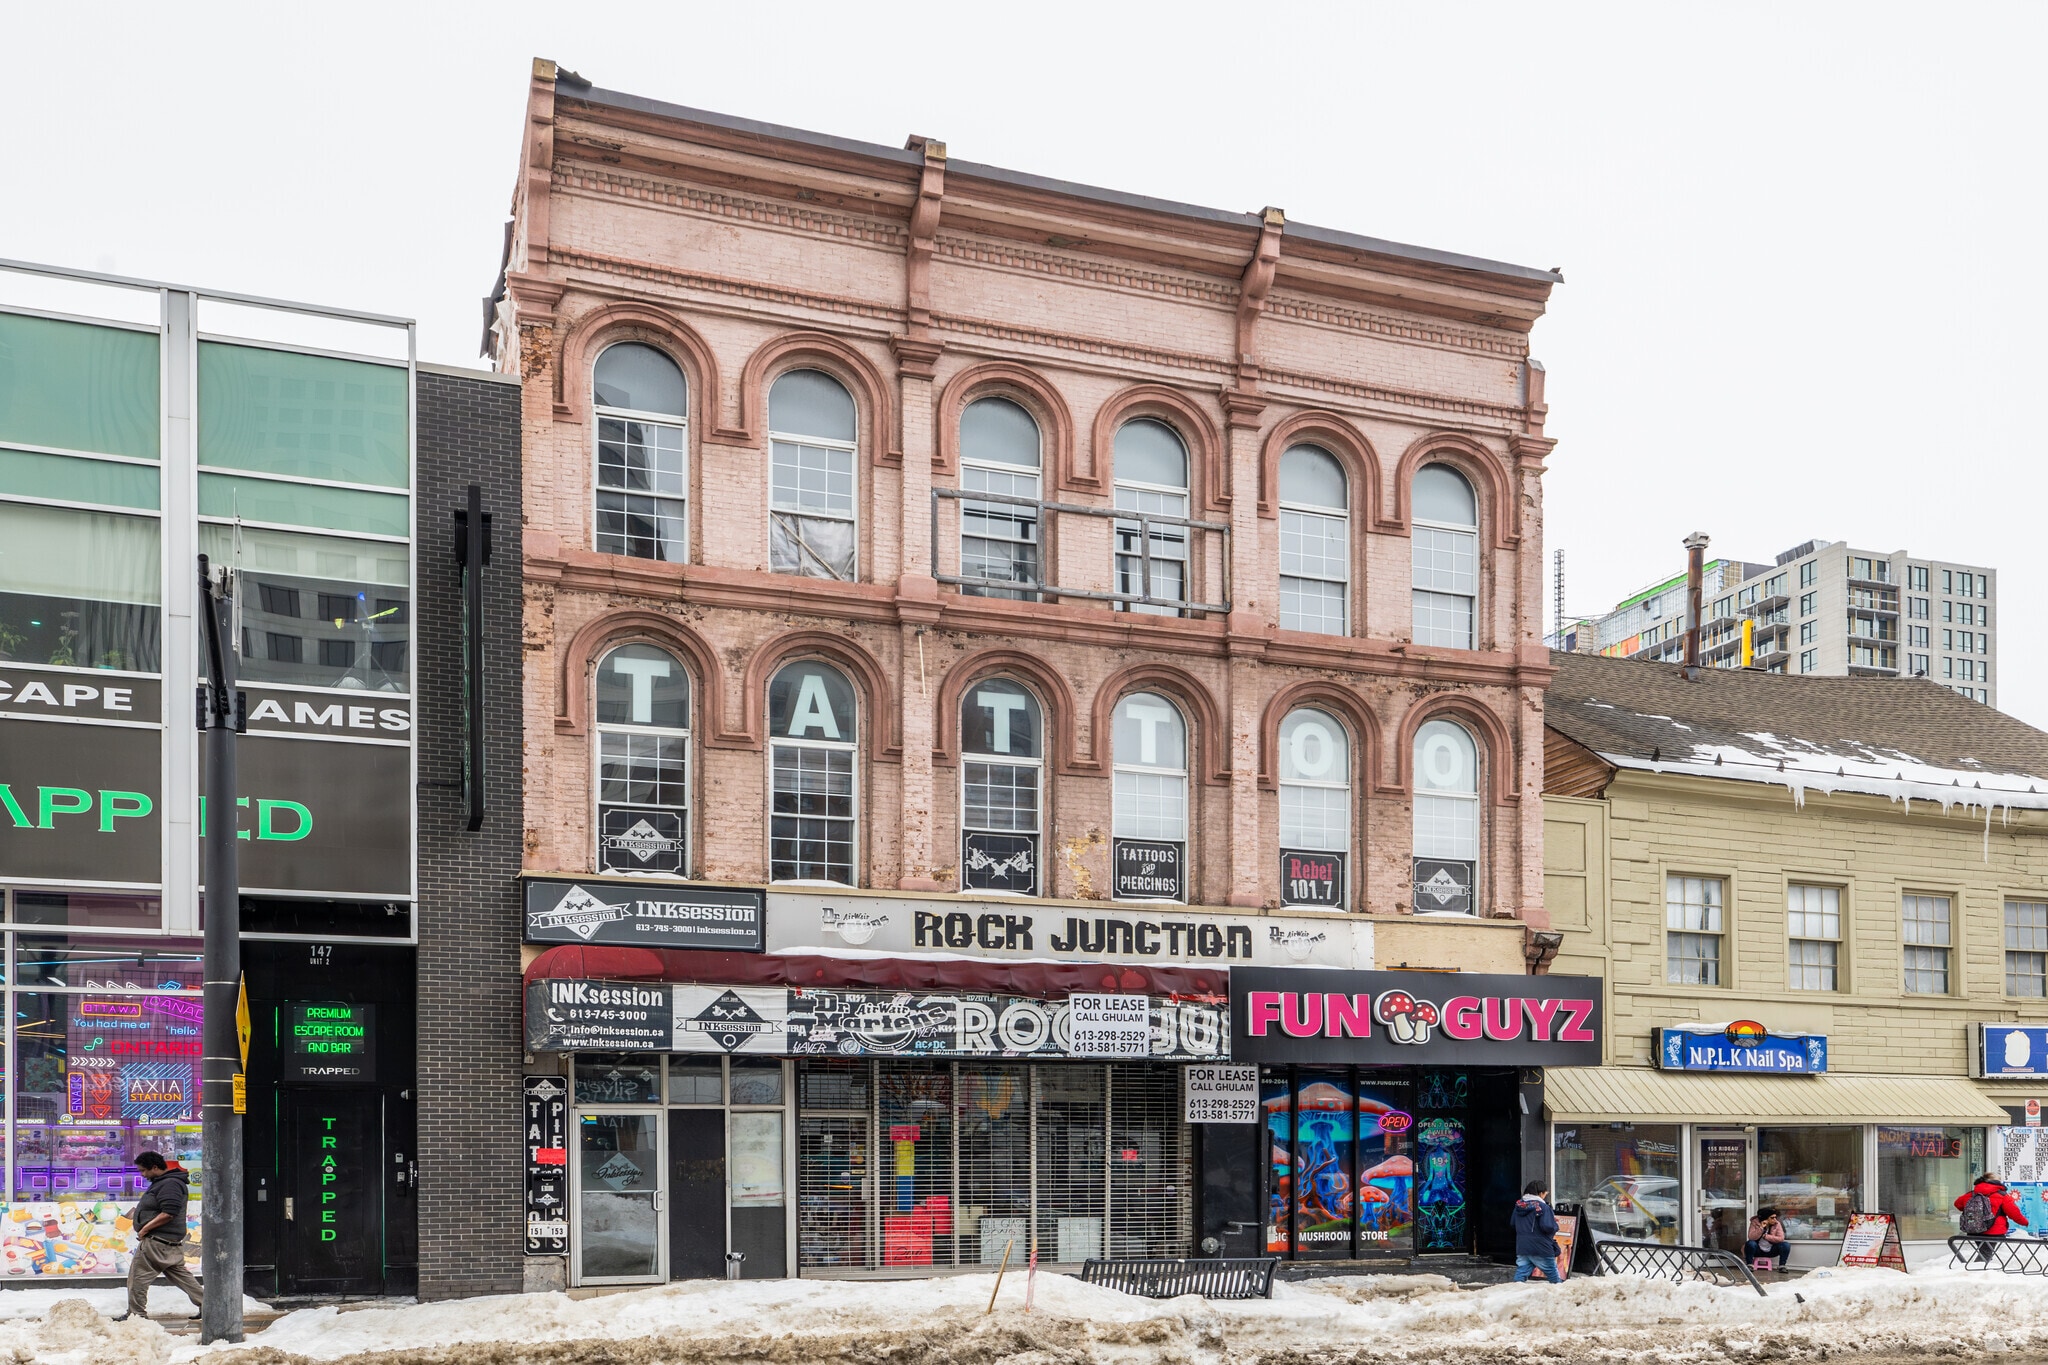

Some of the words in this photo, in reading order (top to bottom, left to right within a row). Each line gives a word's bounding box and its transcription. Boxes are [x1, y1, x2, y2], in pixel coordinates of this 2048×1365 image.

[1121, 848, 1175, 863] TATTOOS
[1141, 863, 1156, 875] AND
[1290, 858, 1333, 880] Rebel
[1120, 875, 1176, 892] PIERCINGS
[1290, 879, 1333, 900] 101.7
[636, 900, 756, 922] INKsession
[914, 911, 1034, 951] ROCK
[1050, 917, 1253, 959] JUNCTION
[310, 945, 332, 957] 147
[325, 958, 330, 966] 2
[551, 982, 663, 1007] INKsession
[84, 1003, 138, 1014] OTTAWA
[1074, 998, 1109, 1011] FOR
[1112, 998, 1145, 1012] LEASE
[307, 1008, 351, 1019] PREMIUM
[569, 1008, 647, 1021] 613-745-3000
[1076, 1013, 1101, 1022] CALL
[1102, 1013, 1144, 1023] GHULAM
[1248, 991, 1371, 1038] FUN
[1441, 995, 1594, 1042] GUYZ
[73, 1018, 92, 1028] You
[96, 1018, 118, 1029] had
[120, 1021, 136, 1030] me
[139, 1021, 151, 1029] at
[698, 1022, 762, 1033] INKsession
[294, 1025, 333, 1036] ESCAPE
[335, 1026, 364, 1037] ROOM
[1074, 1031, 1146, 1042] 613-298-2529
[111, 1040, 203, 1055] ONTARIO
[308, 1042, 328, 1053] AND
[330, 1042, 351, 1053] BAR
[1074, 1042, 1145, 1053] 613-581-5771
[1690, 1046, 1742, 1067] N.P.L.K
[1745, 1049, 1774, 1068] Nail
[1778, 1050, 1803, 1072] Spa
[300, 1066, 360, 1075] TRAPPED
[1189, 1069, 1215, 1081] FOR
[1218, 1069, 1256, 1082] LEASE
[131, 1080, 181, 1093] AXIA
[1191, 1082, 1213, 1091] CALL
[1215, 1083, 1254, 1092] GHULAM
[71, 1075, 83, 1112] SNACK
[130, 1093, 182, 1101] STATION
[1189, 1099, 1256, 1109] 613-298-2529
[1189, 1110, 1255, 1120] 613-581-5771
[1380, 1116, 1409, 1128] OPEN
[1911, 1140, 1963, 1158] NAILS
[1431, 1157, 1449, 1165] 19+
[321, 1117, 337, 1241] TRAPPED
[530, 1227, 543, 1235] 151
[551, 1227, 564, 1235] 153
[1298, 1231, 1352, 1242] MUSHROOM
[1361, 1230, 1388, 1241] STORE
